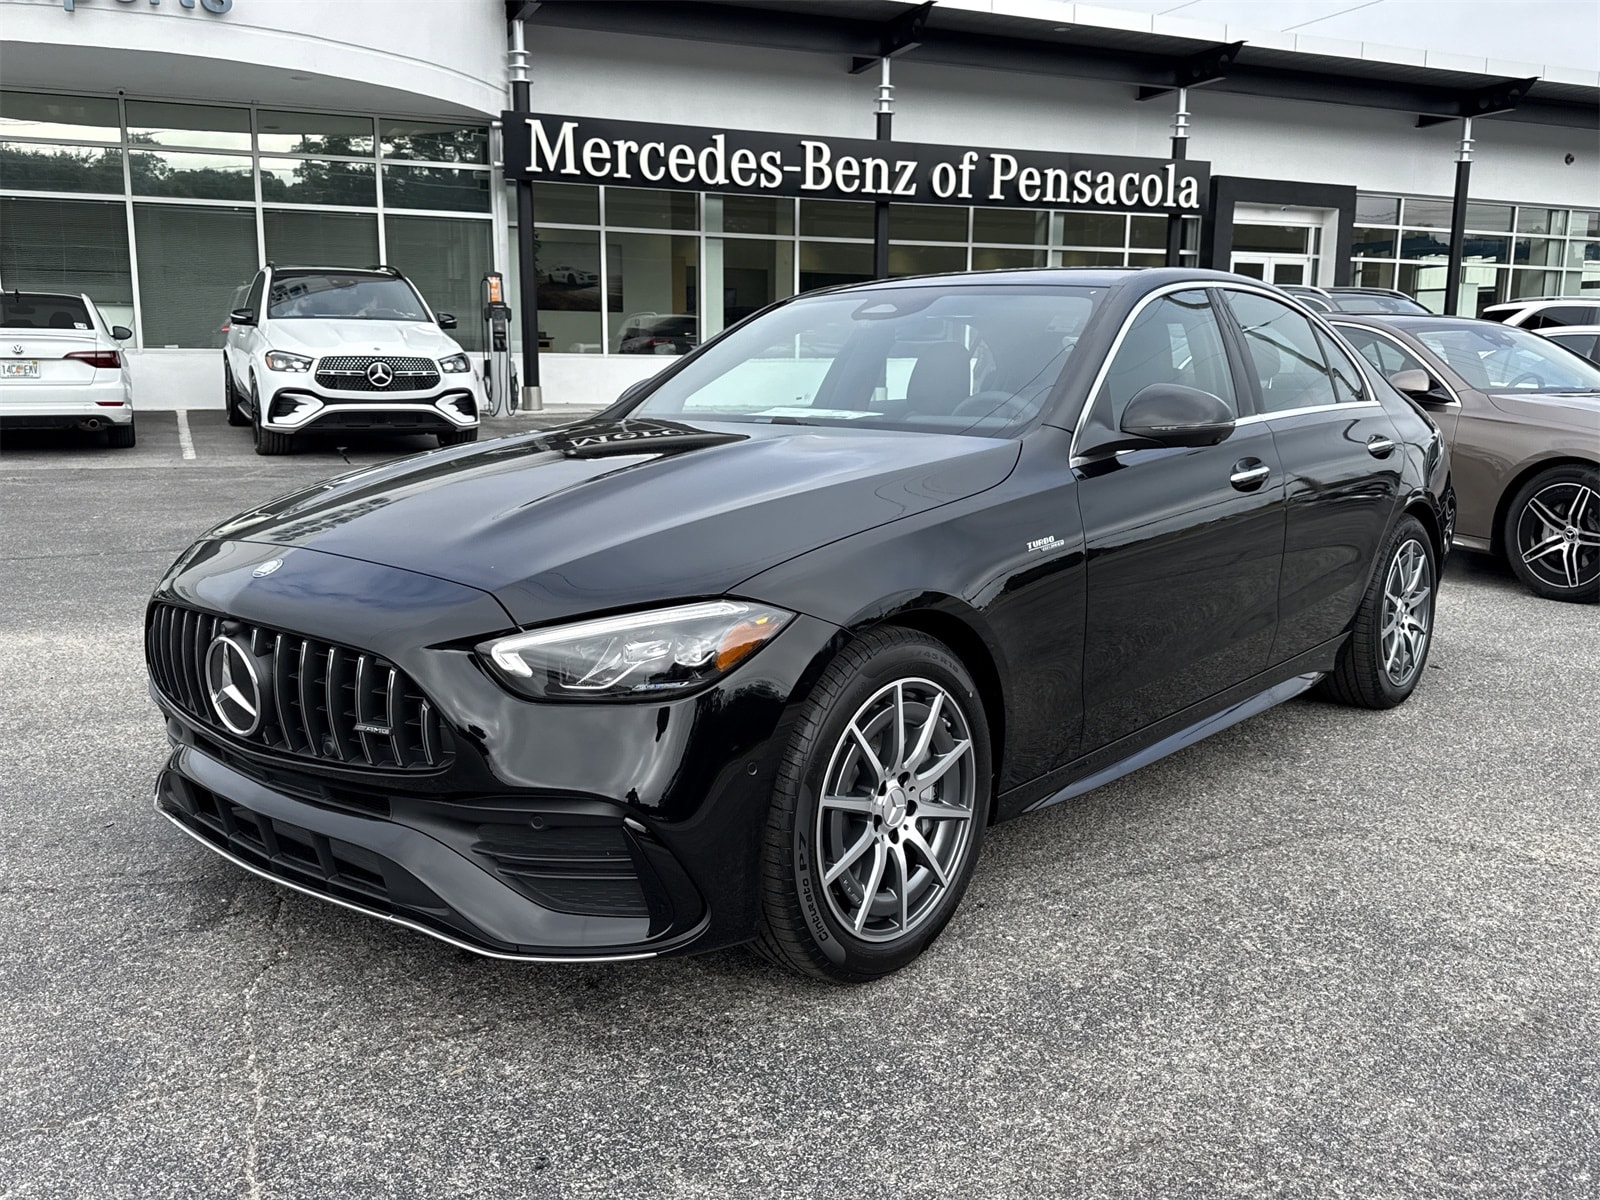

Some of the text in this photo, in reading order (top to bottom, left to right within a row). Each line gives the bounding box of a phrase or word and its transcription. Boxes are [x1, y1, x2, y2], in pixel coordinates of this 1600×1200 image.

[525, 118, 1201, 209] Mercedes-Benz of Pensacola
[1026, 535, 1055, 549] TURBO
[365, 726, 390, 735] AMG
[799, 831, 829, 941] Cinturato P7
